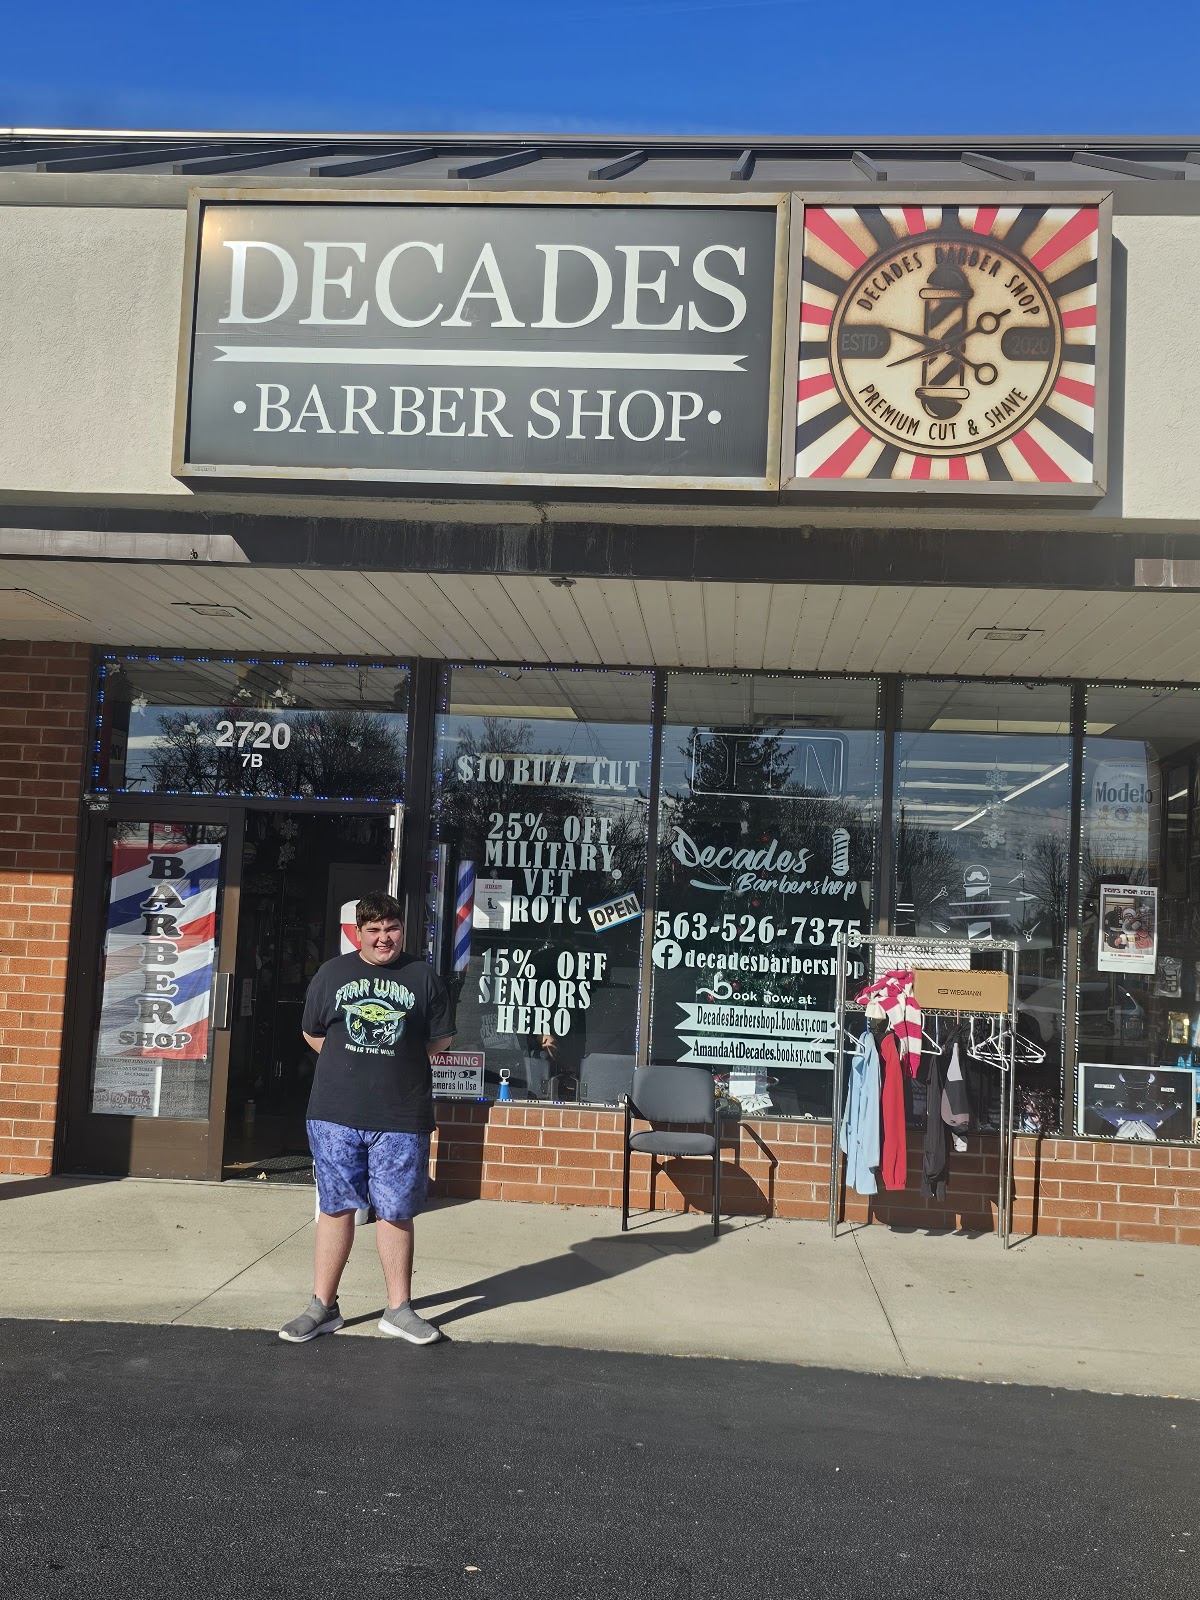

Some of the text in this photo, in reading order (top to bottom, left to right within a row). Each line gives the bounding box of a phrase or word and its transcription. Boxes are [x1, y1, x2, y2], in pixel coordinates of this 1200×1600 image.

[218, 240, 748, 334] DECADES
[856, 247, 1041, 315] DECADES BARBER SHOP
[253, 384, 704, 442] BARBER SHOP
[858, 383, 1028, 441] PREMIUM CUT & SHAVE
[215, 720, 291, 750] 2720
[240, 753, 263, 768] 7B
[457, 754, 641, 788] $10 BUZZ CUT
[1095, 782, 1153, 804] Modelo
[487, 812, 613, 844] 25% OFF
[484, 839, 616, 872] MILITARY
[671, 825, 815, 873] Decades
[522, 868, 573, 897] VET
[736, 872, 857, 901] Barbershop
[511, 895, 582, 924] ROTC
[593, 895, 639, 927] OPEN
[141, 855, 187, 1026] BARBER
[655, 910, 861, 948] 563-526-7375
[481, 948, 607, 981] 15% OFF
[684, 948, 865, 980] decadesbarbershop
[335, 977, 416, 1011] STAR WARS
[478, 975, 591, 1010] SENIORS
[763, 991, 795, 1004] now
[798, 994, 817, 1005] at:
[949, 989, 982, 997] WIEGMANN
[496, 1005, 570, 1037] HERO
[118, 1031, 191, 1049] SHOP
[365, 1047, 379, 1055] THE
[692, 1039, 822, 1066] AmandaAtDecades.booksy.com
[428, 1055, 479, 1066] WARNING
[130, 1095, 148, 1106] TOTS
[432, 1081, 477, 1091] ameras In Use
